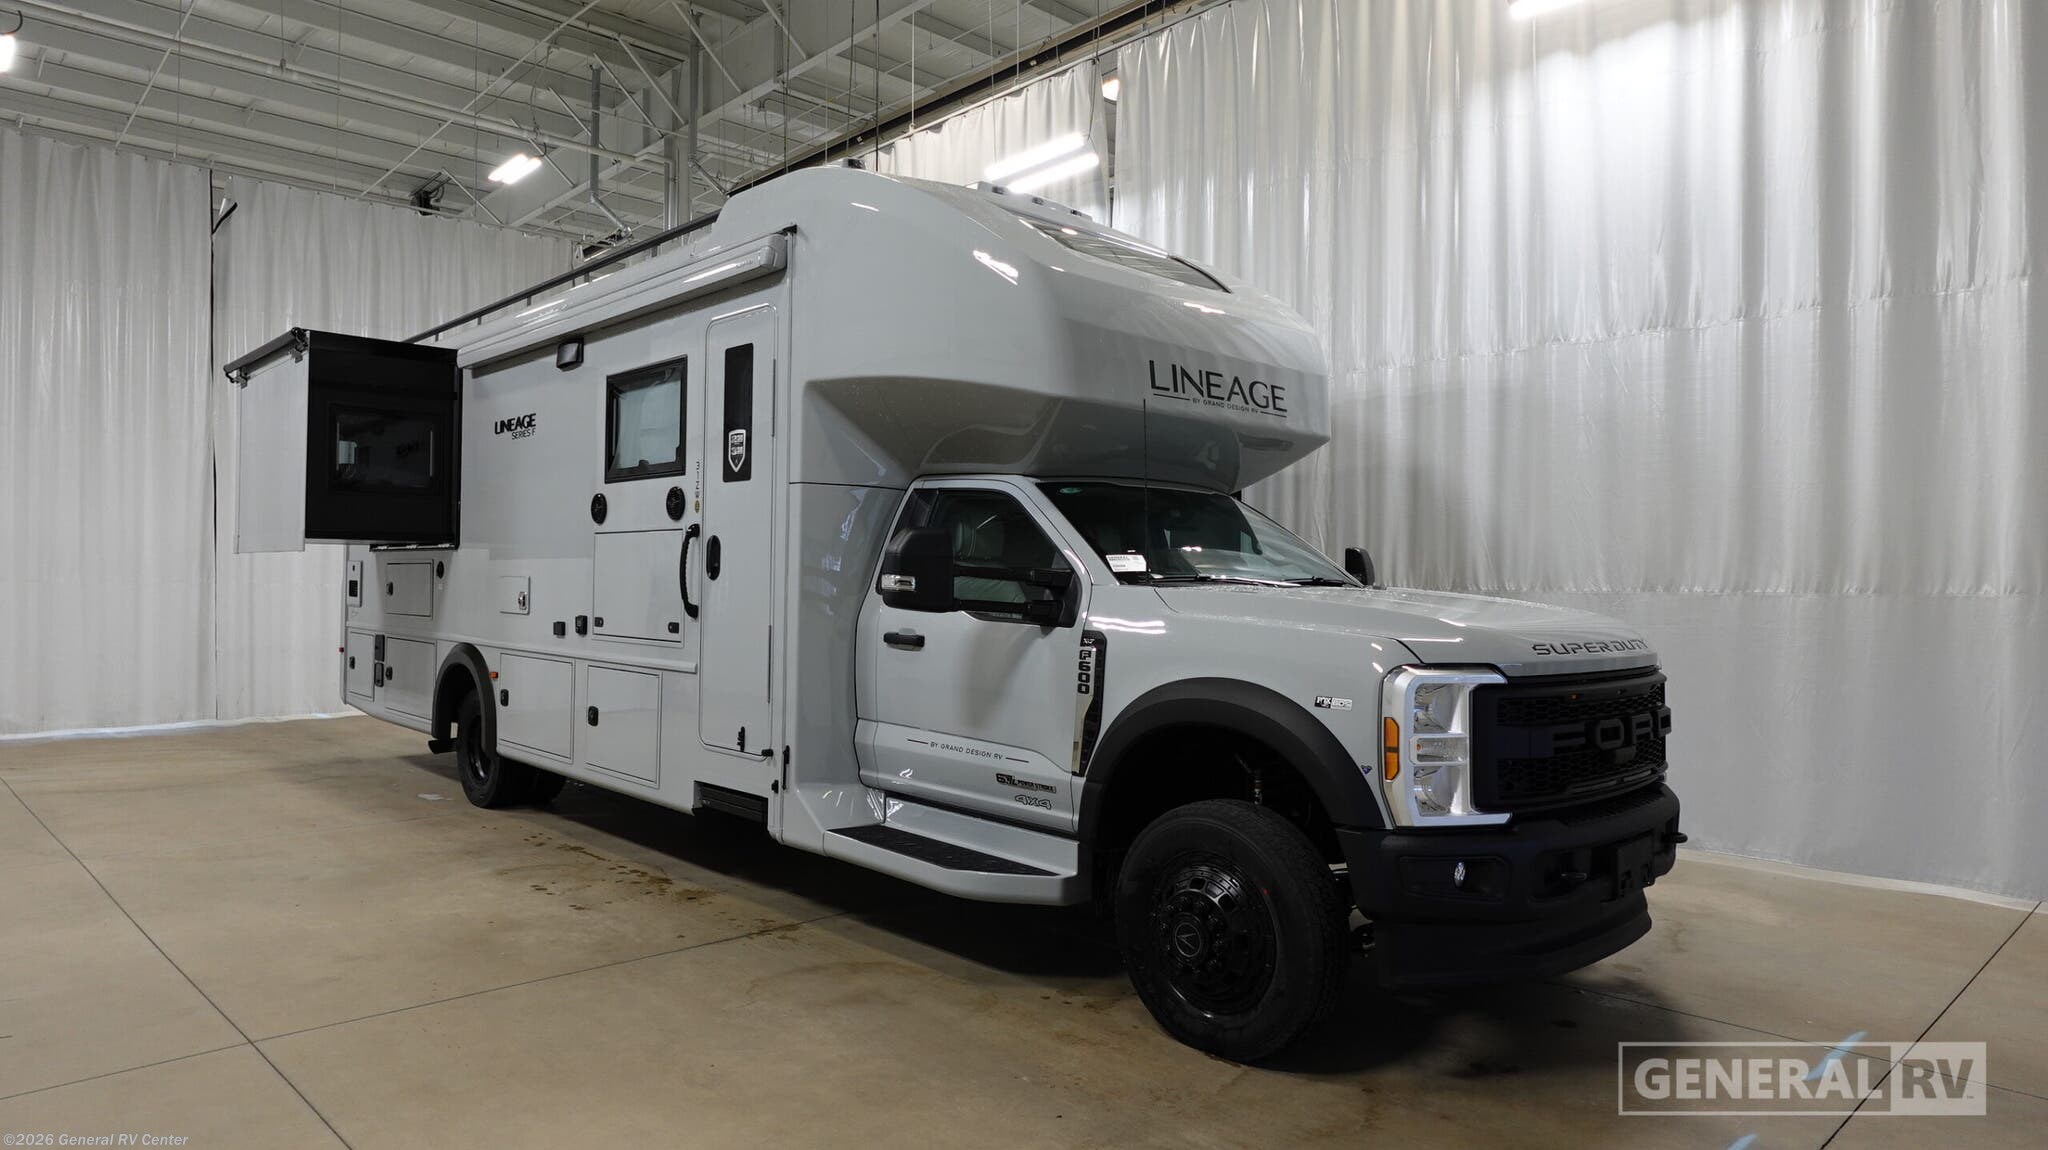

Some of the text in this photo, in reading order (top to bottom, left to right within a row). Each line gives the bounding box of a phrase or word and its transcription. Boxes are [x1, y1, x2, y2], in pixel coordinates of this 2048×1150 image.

[1149, 360, 1287, 413] LINEAGE
[1203, 399, 1225, 408] GRAND
[1227, 403, 1250, 412] DESIGN
[495, 413, 536, 434] LINEAGE
[512, 428, 536, 440] SERIES F
[940, 743, 964, 753] GRAND
[965, 748, 992, 758] DESIGN
[994, 752, 1003, 760] RV
